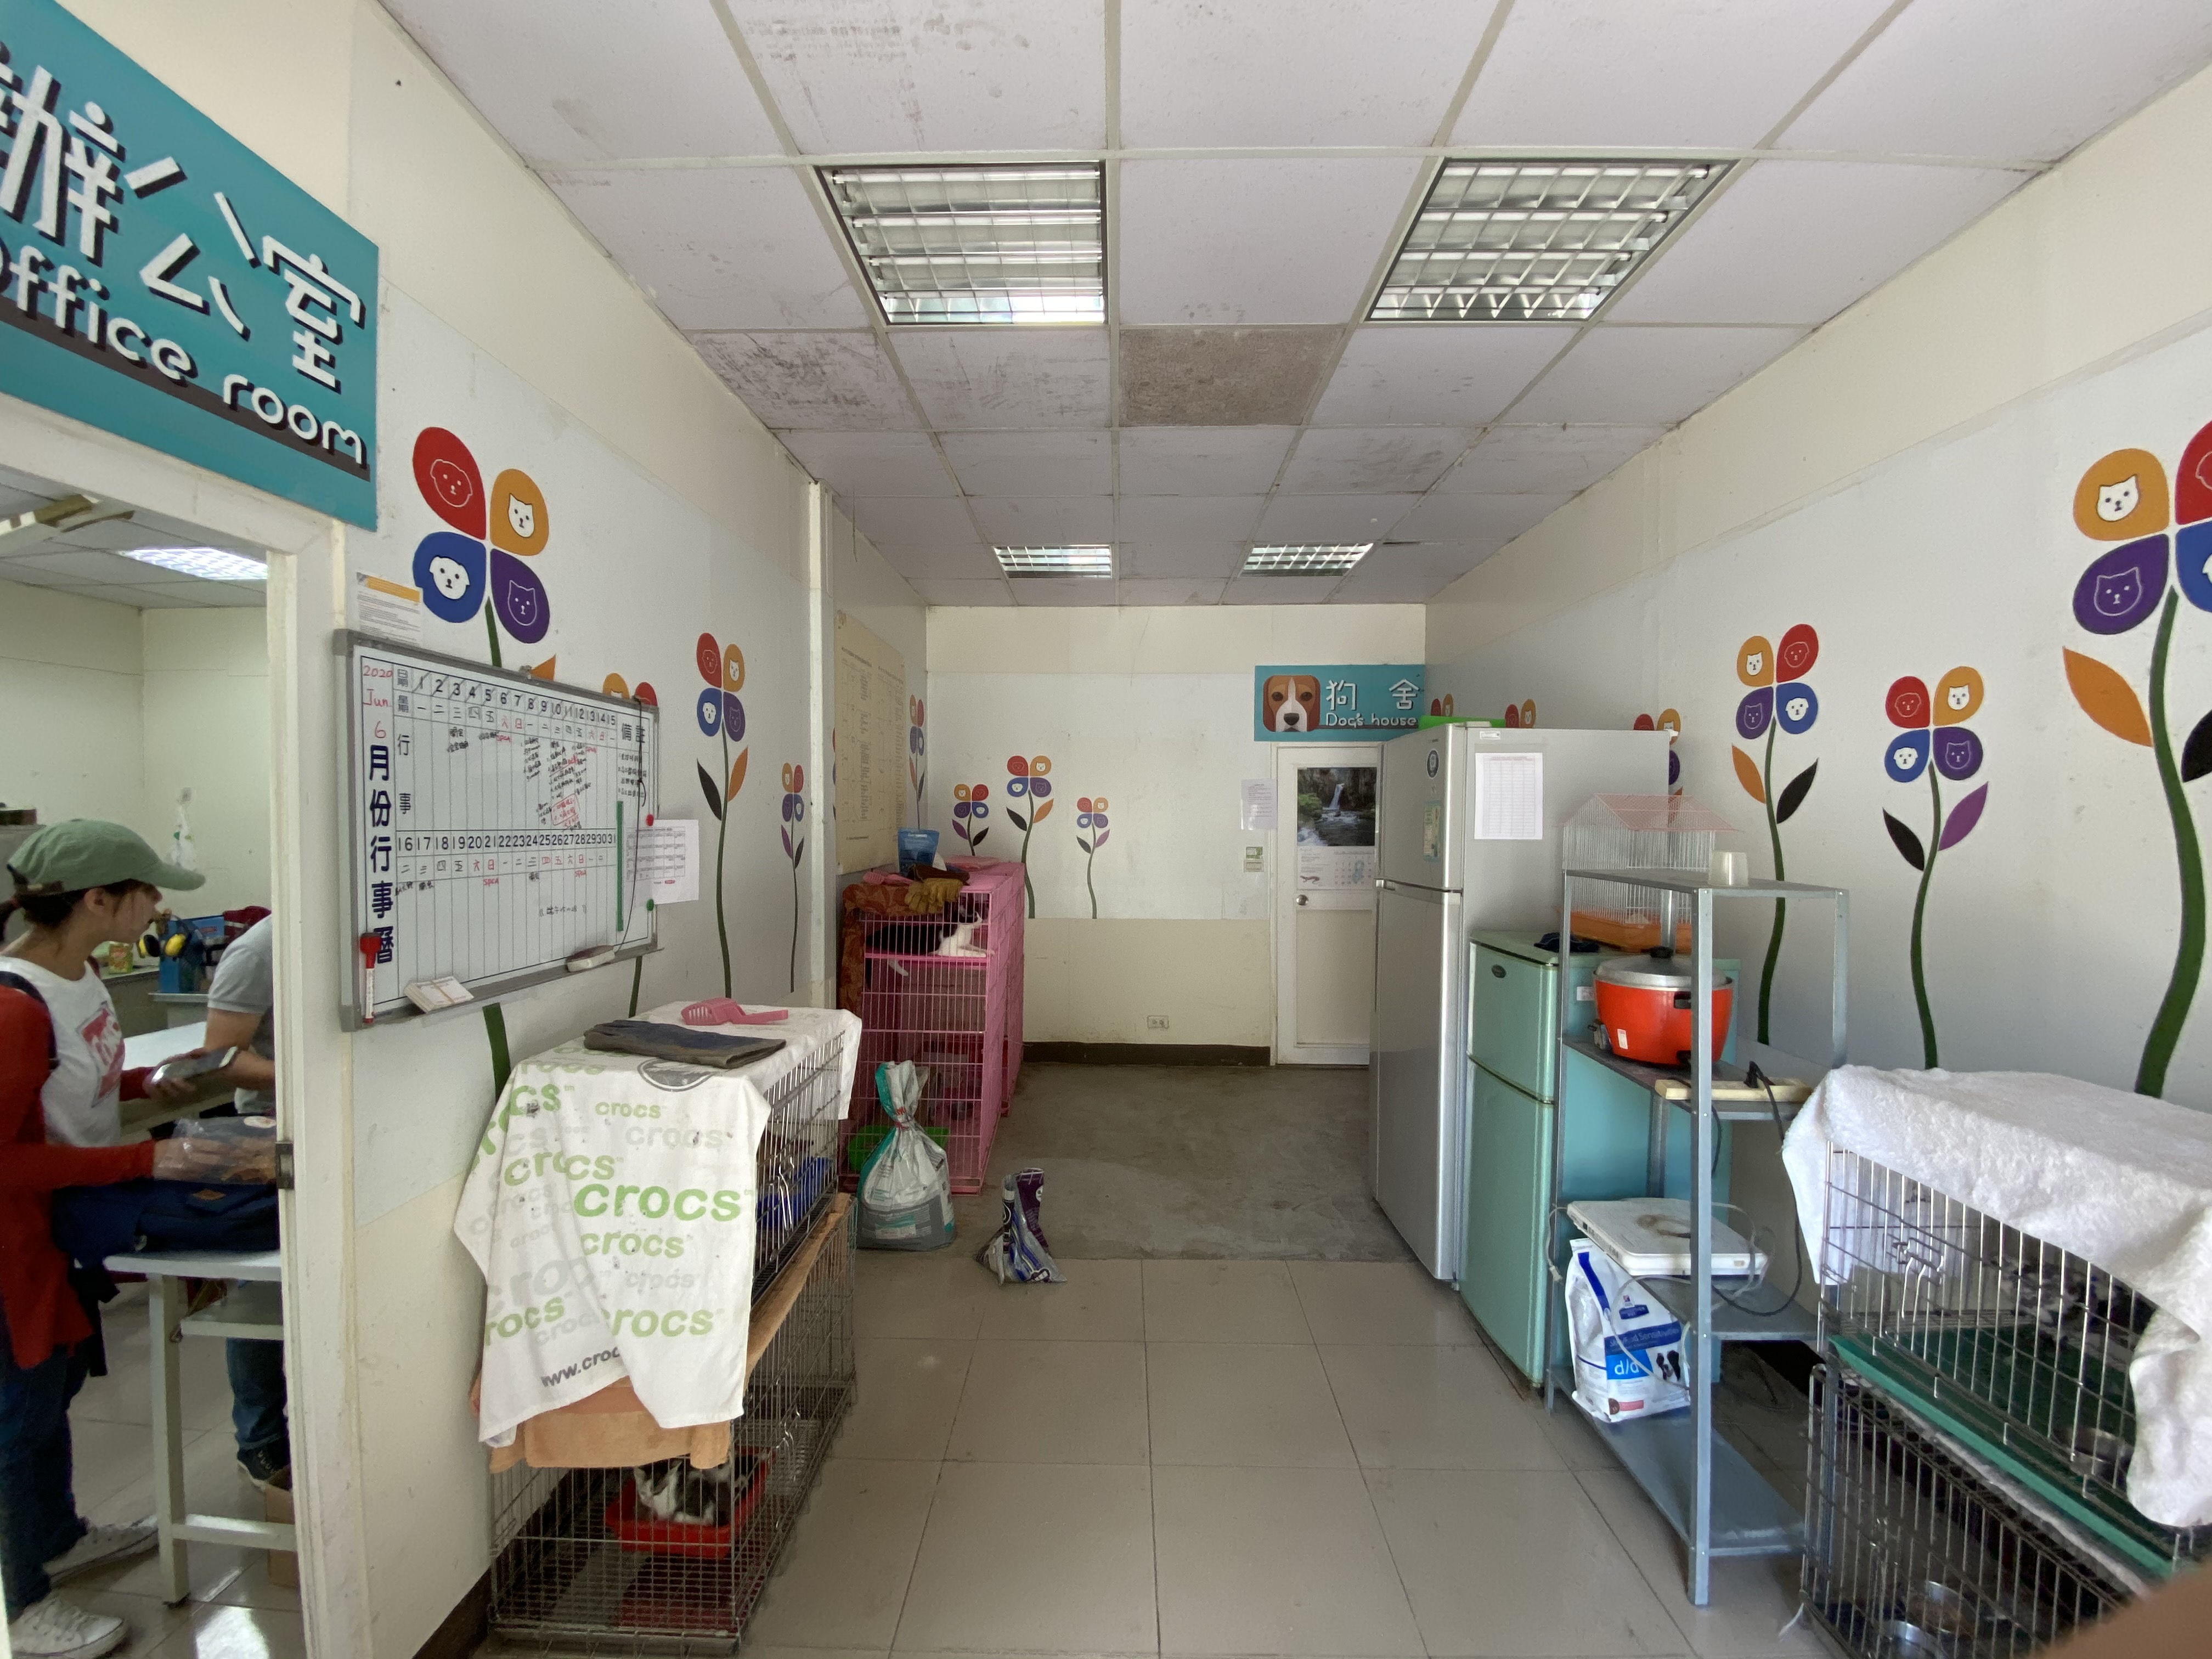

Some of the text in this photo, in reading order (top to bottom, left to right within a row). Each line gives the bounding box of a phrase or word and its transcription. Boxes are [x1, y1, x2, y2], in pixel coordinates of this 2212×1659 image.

[0, 244, 362, 465] ffice room
[363, 664, 393, 678] 2020
[363, 689, 388, 707] Jun
[435, 679, 443, 693] 2
[453, 682, 461, 696] 3
[469, 686, 476, 698] 4
[485, 689, 492, 702] 5
[500, 692, 507, 705] 6
[514, 694, 521, 707] 7
[528, 697, 535, 710] 8
[540, 700, 548, 712] 9
[551, 702, 561, 715] 10
[576, 707, 585, 720] 12
[586, 710, 596, 722] 13
[597, 713, 606, 723] 14
[608, 714, 616, 725] 15
[374, 720, 387, 739] 6
[1372, 713, 1418, 727] house
[398, 833, 616, 851] 16 17 18 19 20 21 22 23 24 25 26 27 28 29 30 31
[595, 1102, 661, 1119] crocs
[625, 1126, 724, 1148] crocs
[574, 1183, 741, 1222] crocs
[580, 1231, 684, 1259] crocs
